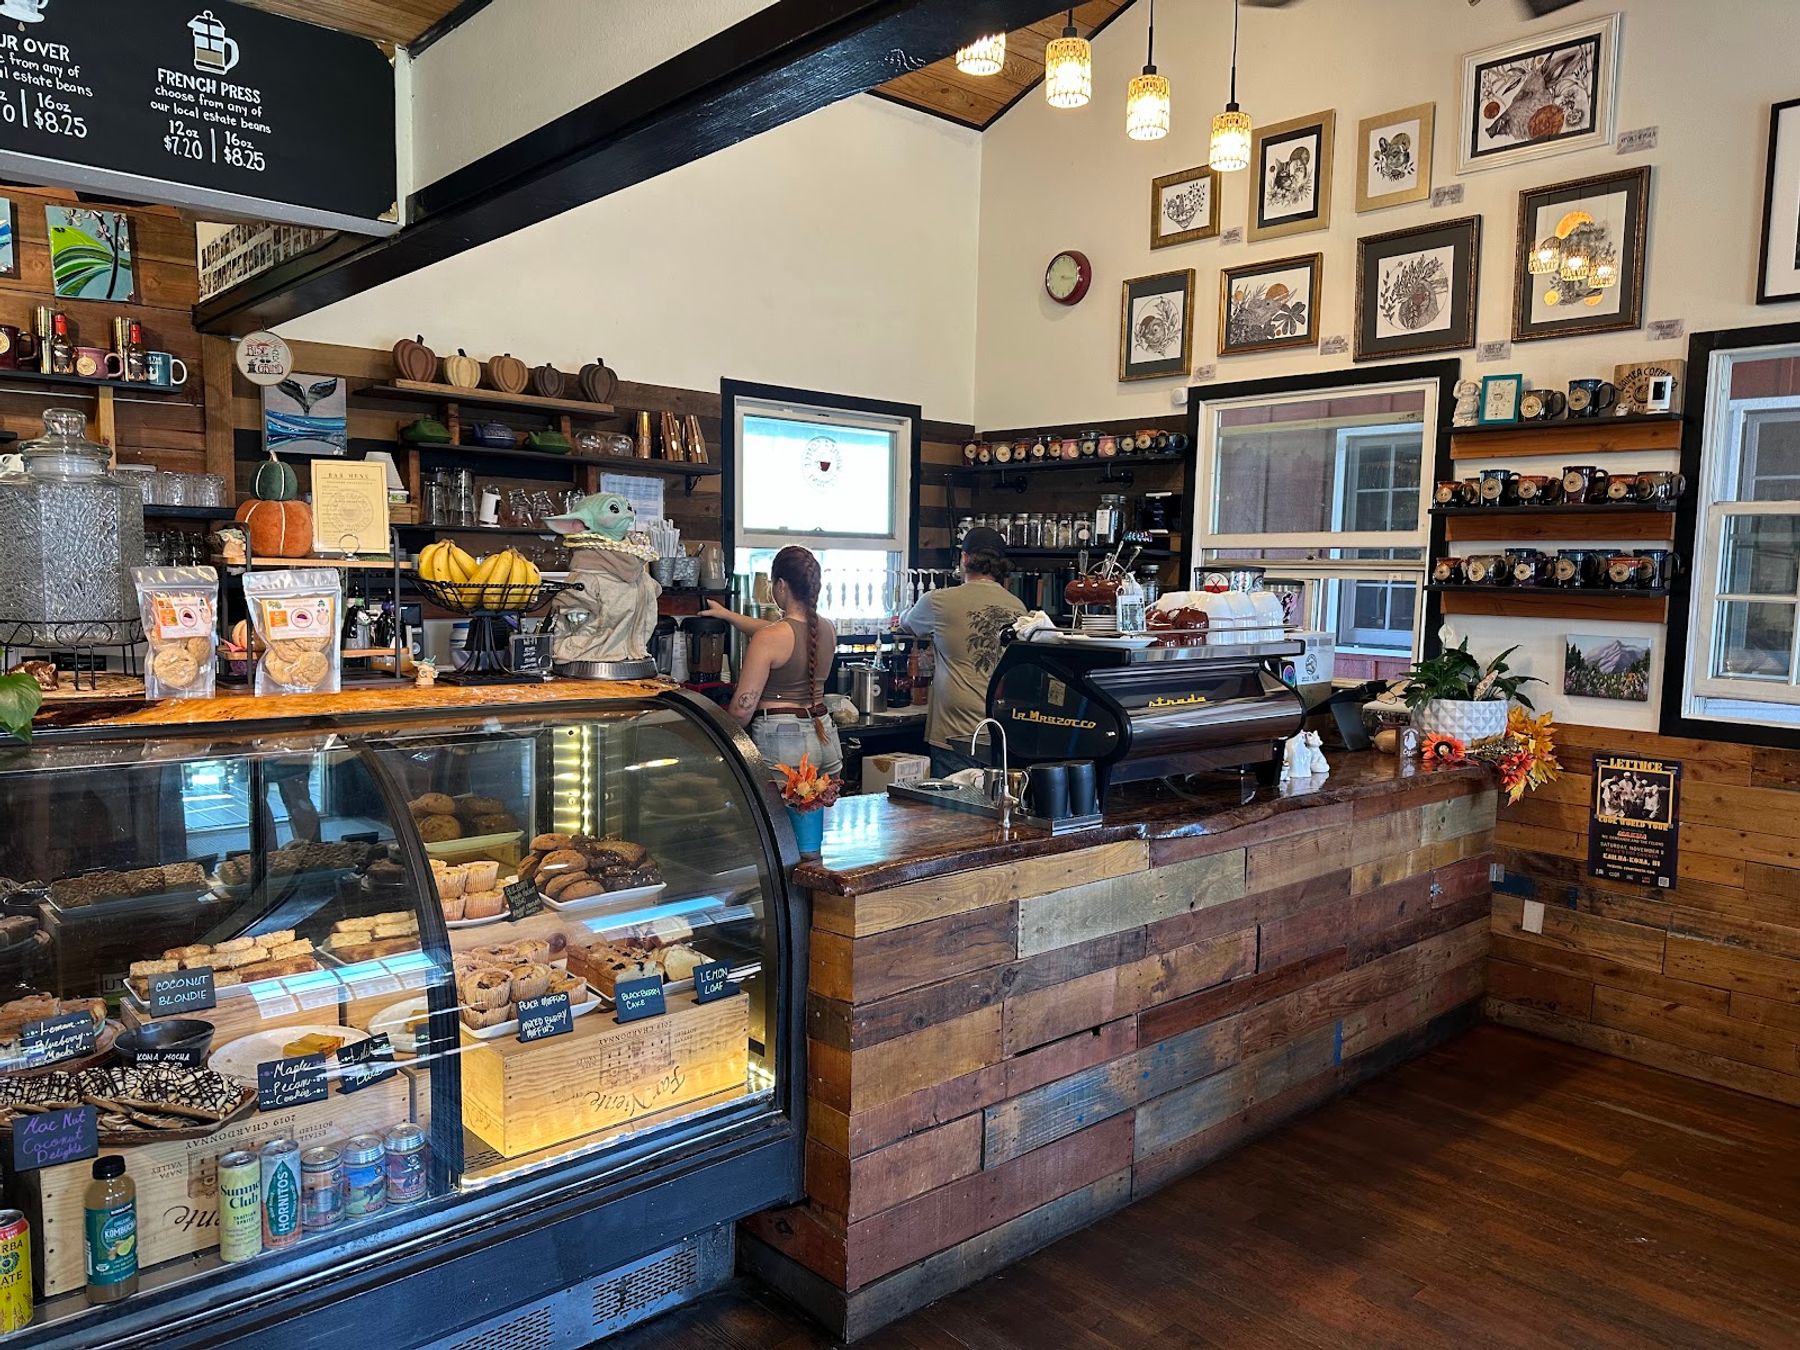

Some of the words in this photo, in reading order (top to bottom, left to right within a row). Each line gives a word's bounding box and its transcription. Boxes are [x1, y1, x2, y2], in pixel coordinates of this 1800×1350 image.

[23, 38, 70, 62] OVER
[9, 52, 39, 71] from
[42, 63, 62, 78] any
[68, 65, 80, 78] of
[13, 71, 53, 88] estate
[56, 77, 93, 97] beans
[158, 67, 216, 94] FRENCH
[221, 82, 261, 104] PRESS
[155, 85, 195, 102] choose
[199, 93, 224, 109] from
[228, 103, 247, 116] any
[251, 106, 262, 117] of
[33, 108, 87, 138] $8.25
[150, 101, 169, 112] our
[173, 103, 199, 119] local
[203, 111, 237, 126] estate
[241, 117, 271, 133] beans
[164, 135, 203, 160] $7.20
[224, 145, 266, 171] $8.25
[1609, 757, 1663, 771] LETTUCE
[156, 975, 209, 992] COCONUT
[700, 968, 728, 983] LEMON
[158, 989, 207, 1006] BLONDIE
[704, 981, 723, 994] LOAF
[626, 999, 646, 1010] CAKE
[40, 1021, 76, 1036] Lemon
[599, 1026, 654, 1045] CHARDONNAY
[136, 1053, 159, 1061] KONA
[164, 1053, 190, 1061] MOCHA
[273, 1060, 312, 1081] Maple
[273, 1078, 311, 1095] Pecan
[652, 1066, 686, 1098] Far
[583, 1090, 653, 1116] Niente
[23, 1116, 59, 1134] Mac
[63, 1109, 86, 1129] Nut
[273, 1114, 296, 1127] 2019
[299, 1121, 333, 1134] BOTTLED
[22, 1126, 84, 1154] Coconut
[185, 1121, 268, 1149] CHARDONNAY
[151, 1161, 183, 1175] VALLEY
[159, 1170, 183, 1180] NAPA
[277, 1171, 290, 1232] HORNITOS
[162, 1205, 221, 1231] ente
